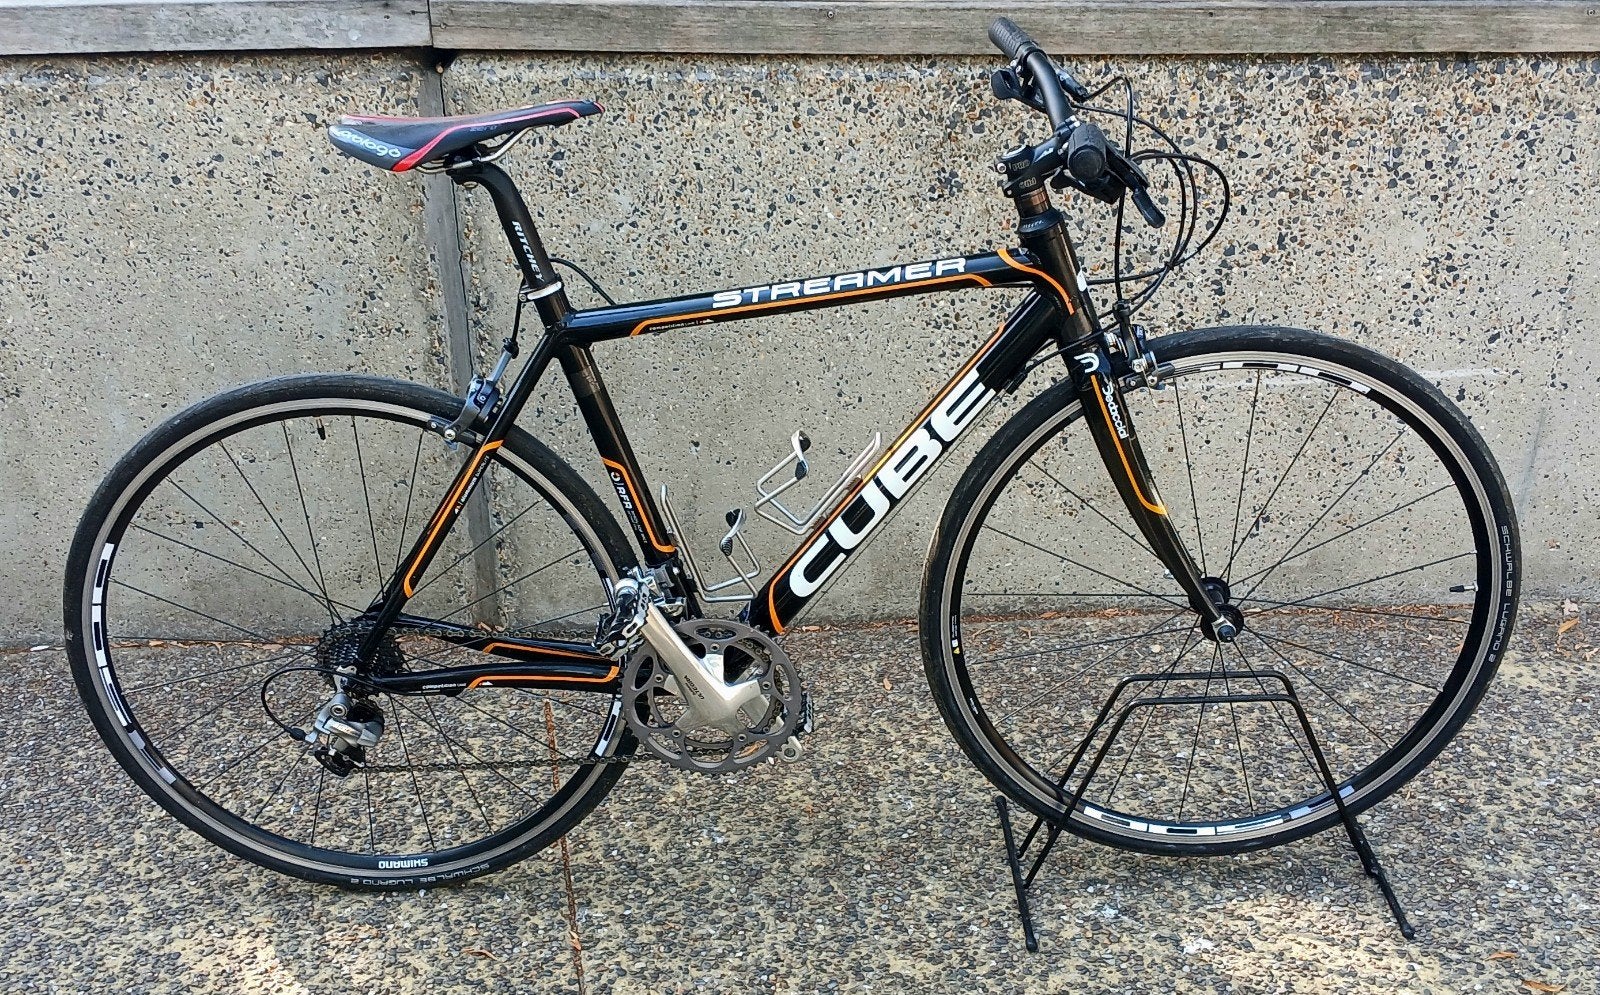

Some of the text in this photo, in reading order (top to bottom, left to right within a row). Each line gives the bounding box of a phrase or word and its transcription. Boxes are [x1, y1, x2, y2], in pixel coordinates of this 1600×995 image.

[511, 220, 544, 282] RITCHEY
[712, 257, 966, 309] STREAMER
[789, 368, 996, 599] CUBE
[1501, 525, 1513, 597] SCHWALBE
[1492, 602, 1511, 651] LUGANO
[362, 878, 414, 887] LUGANO
[378, 858, 429, 870] SHIMANO
[419, 862, 490, 883] SCHWALBE
